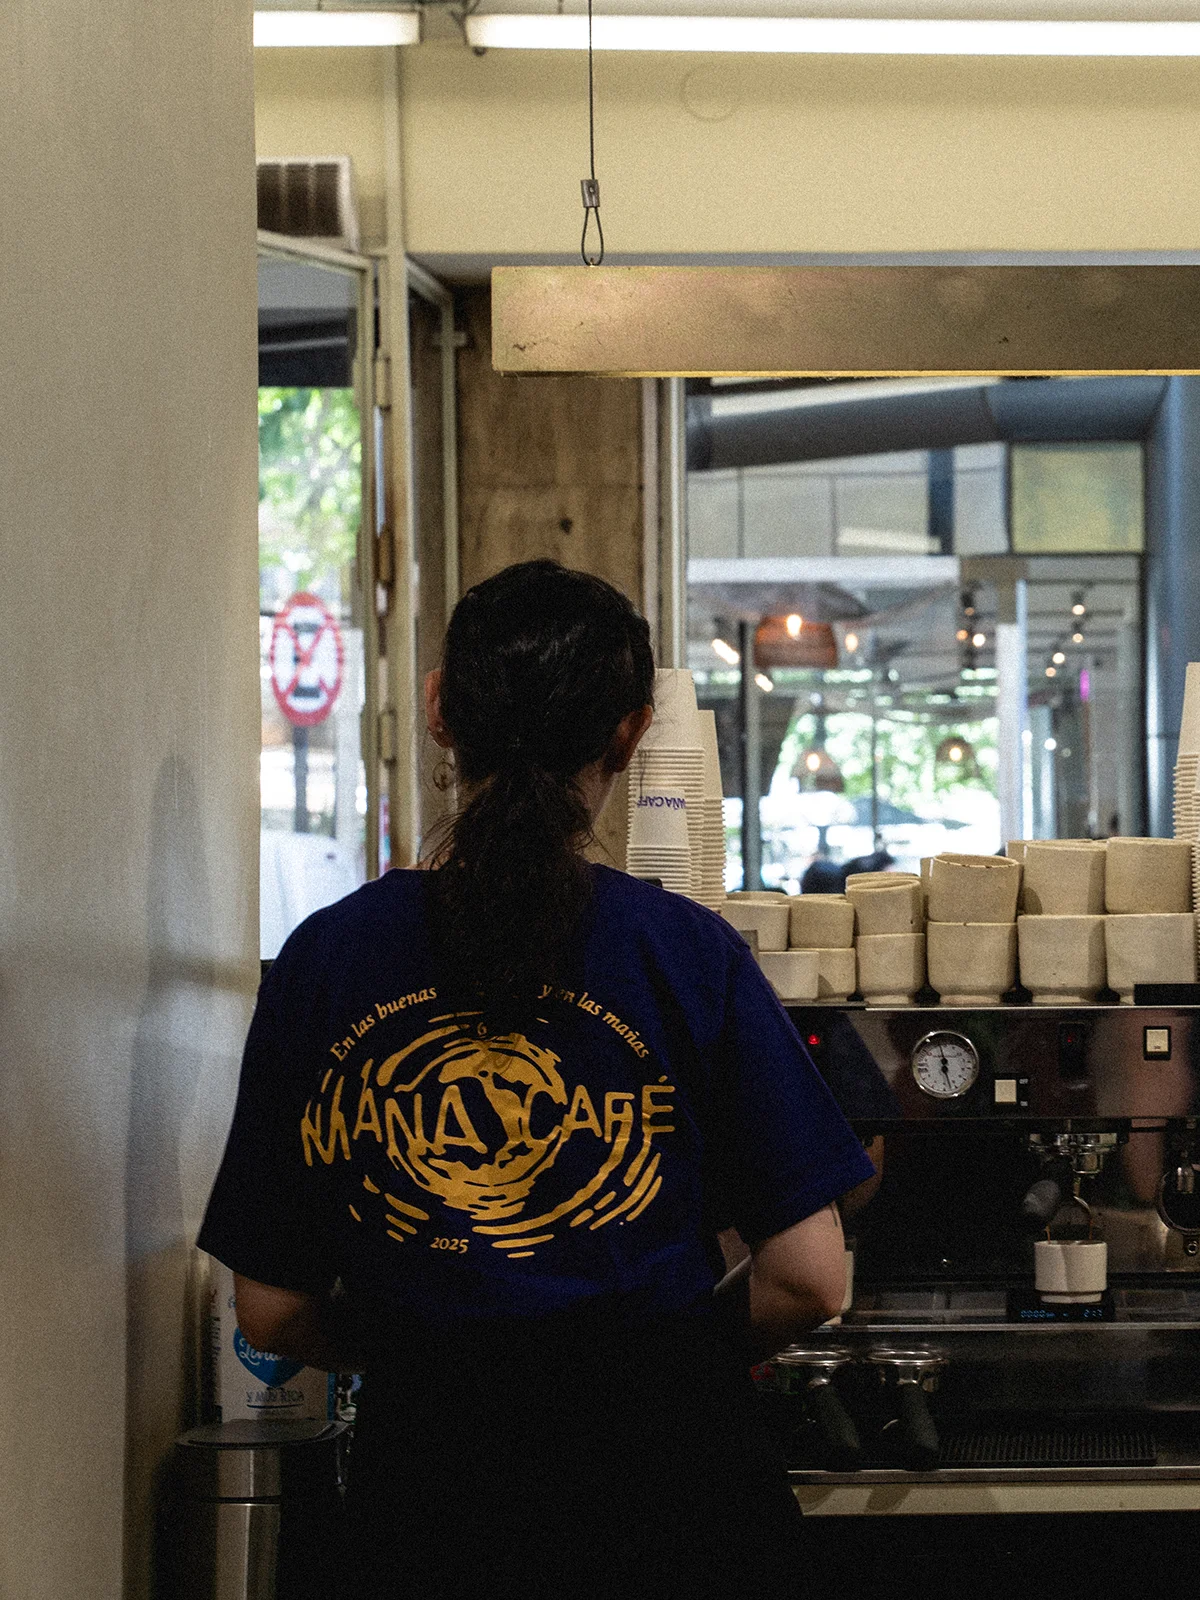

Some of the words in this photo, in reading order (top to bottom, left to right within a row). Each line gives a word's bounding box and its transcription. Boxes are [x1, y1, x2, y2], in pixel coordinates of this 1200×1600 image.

[536, 983, 552, 999] y
[576, 991, 603, 1016] las
[329, 1036, 356, 1062] En
[350, 1014, 376, 1038] las
[374, 987, 438, 1020] buenas
[428, 1235, 471, 1254] 2025
